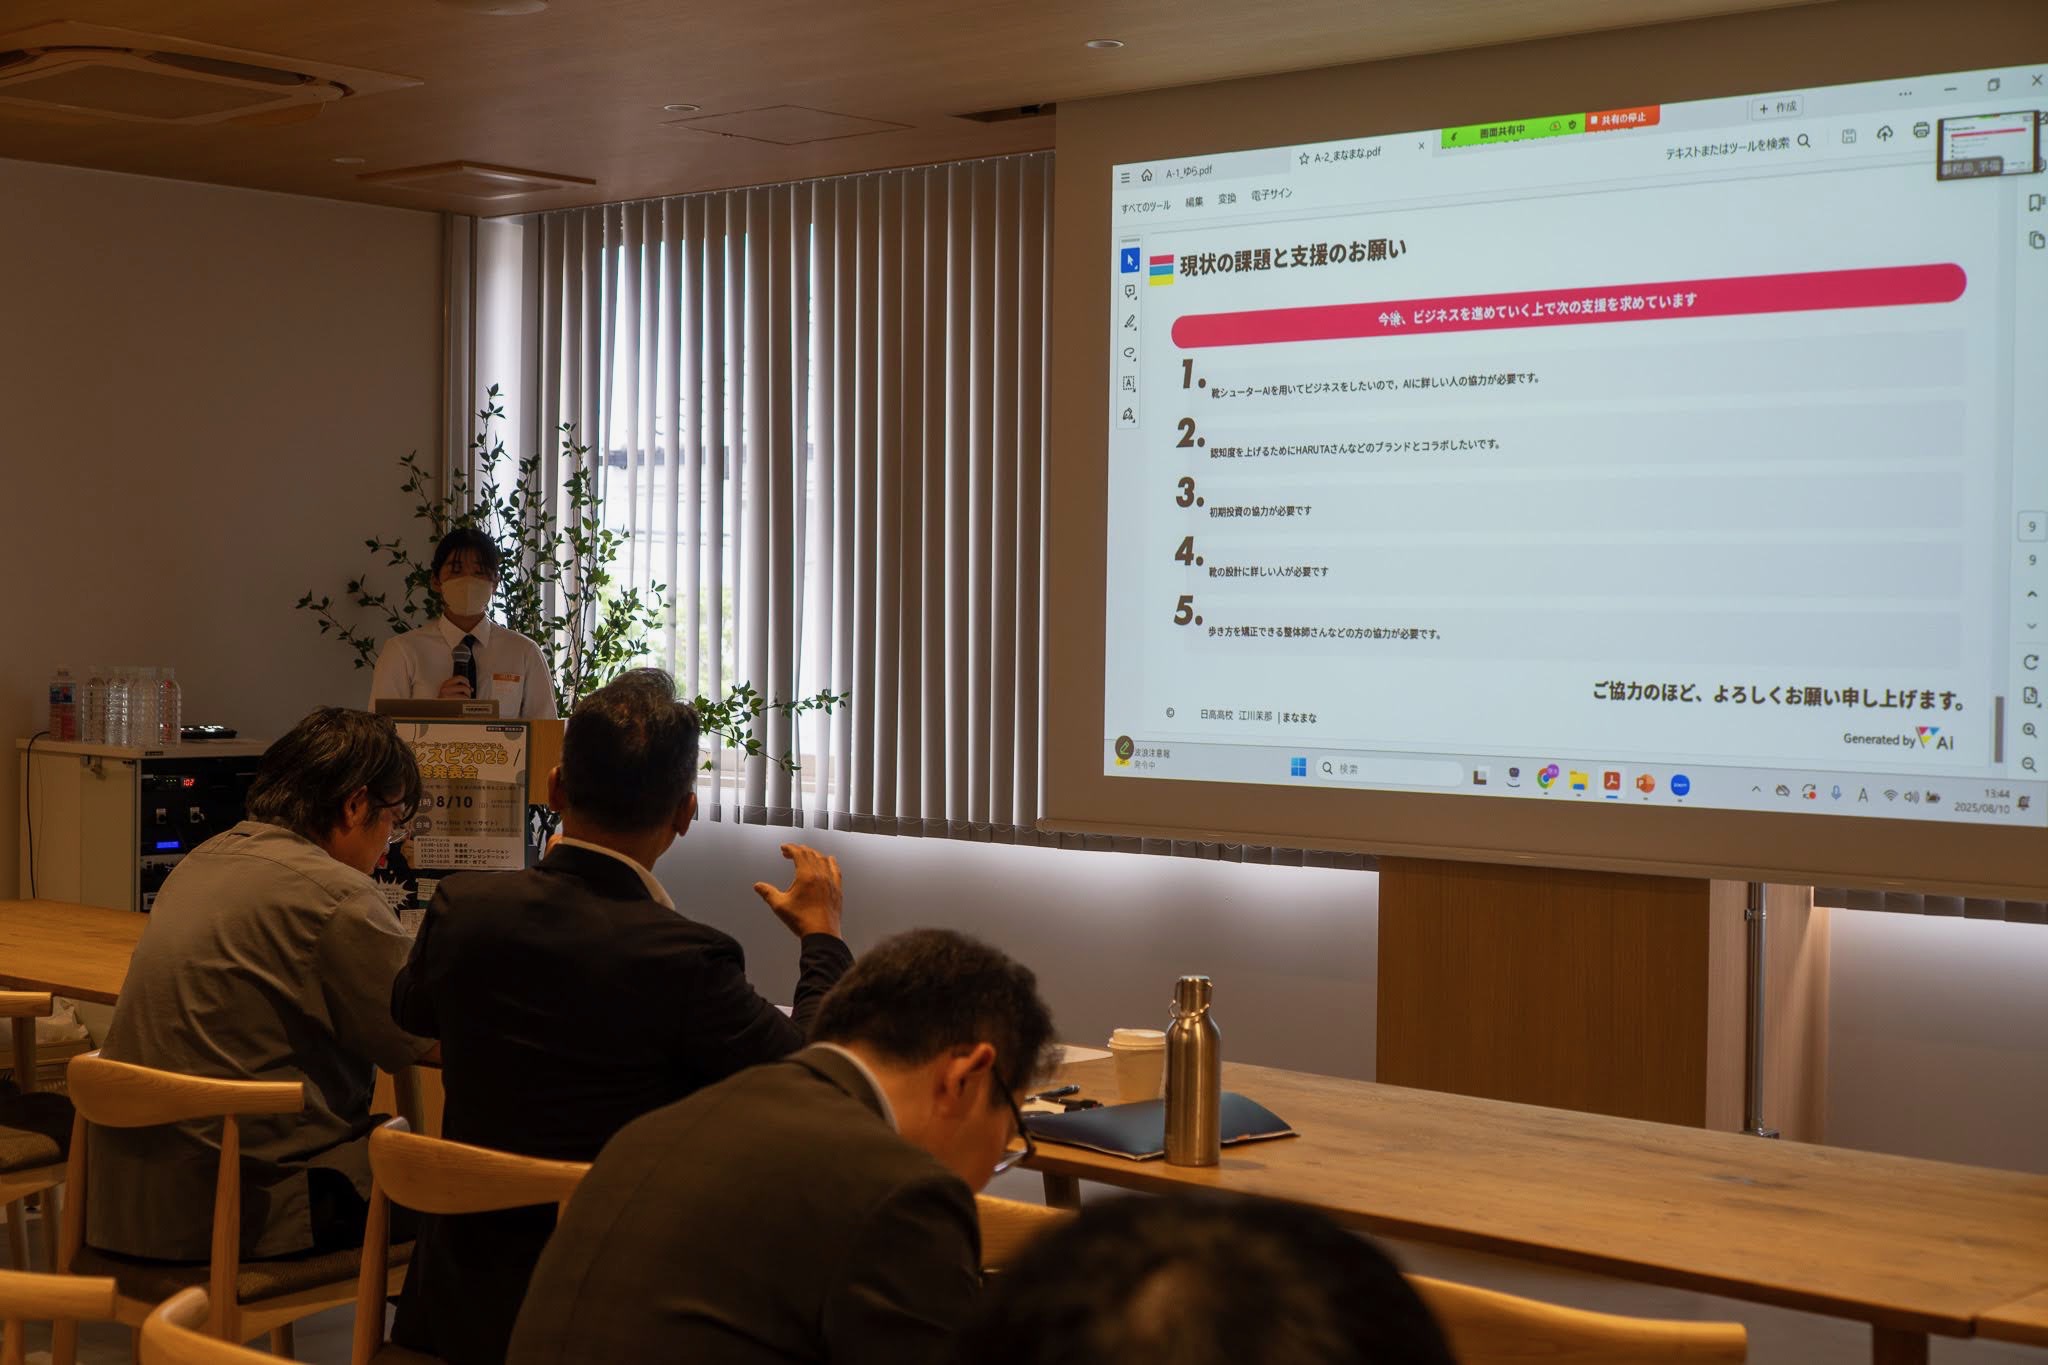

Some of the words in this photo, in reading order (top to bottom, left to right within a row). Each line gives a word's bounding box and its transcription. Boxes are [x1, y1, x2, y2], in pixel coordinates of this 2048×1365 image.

[1776, 100, 1797, 113] 作成
[1601, 112, 1647, 126] 共有の停止
[1479, 124, 1526, 139] 画面共有中
[1665, 137, 1790, 161] テキストまたはツールを検索
[1218, 192, 1237, 205] 変換
[1251, 187, 1293, 202] 電子サイン
[1121, 200, 1171, 215] すべてのツール
[1185, 196, 1204, 208] 編集
[1180, 237, 1407, 277] 現状の課題と支援のお願い
[1182, 358, 1207, 389] 1.
[1176, 417, 1205, 448] 2.
[1176, 476, 1205, 508] 3.
[1209, 505, 1312, 518] 初期投資の協力が必要です
[2029, 521, 2037, 533] 9
[1175, 535, 1204, 567] 4.
[2029, 554, 2037, 566] 9
[1209, 566, 1329, 578] 靴の設計に詳しい人が必要です
[1173, 594, 1204, 627] 5.
[1208, 625, 1441, 640] 歩き方を矯正できる整体師さんなどの方の協力が必要です。
[1593, 680, 1965, 713] ご協力のほど、よろしくお願い申し上げます。
[1200, 708, 1234, 721] 日高高校
[1843, 731, 1899, 747] Generated
[1902, 733, 1916, 749] by
[1339, 762, 1359, 776] 検索
[1985, 788, 2011, 799] 13:44
[436, 795, 473, 809] 8/10
[1954, 801, 2011, 815] 2025/08/10
